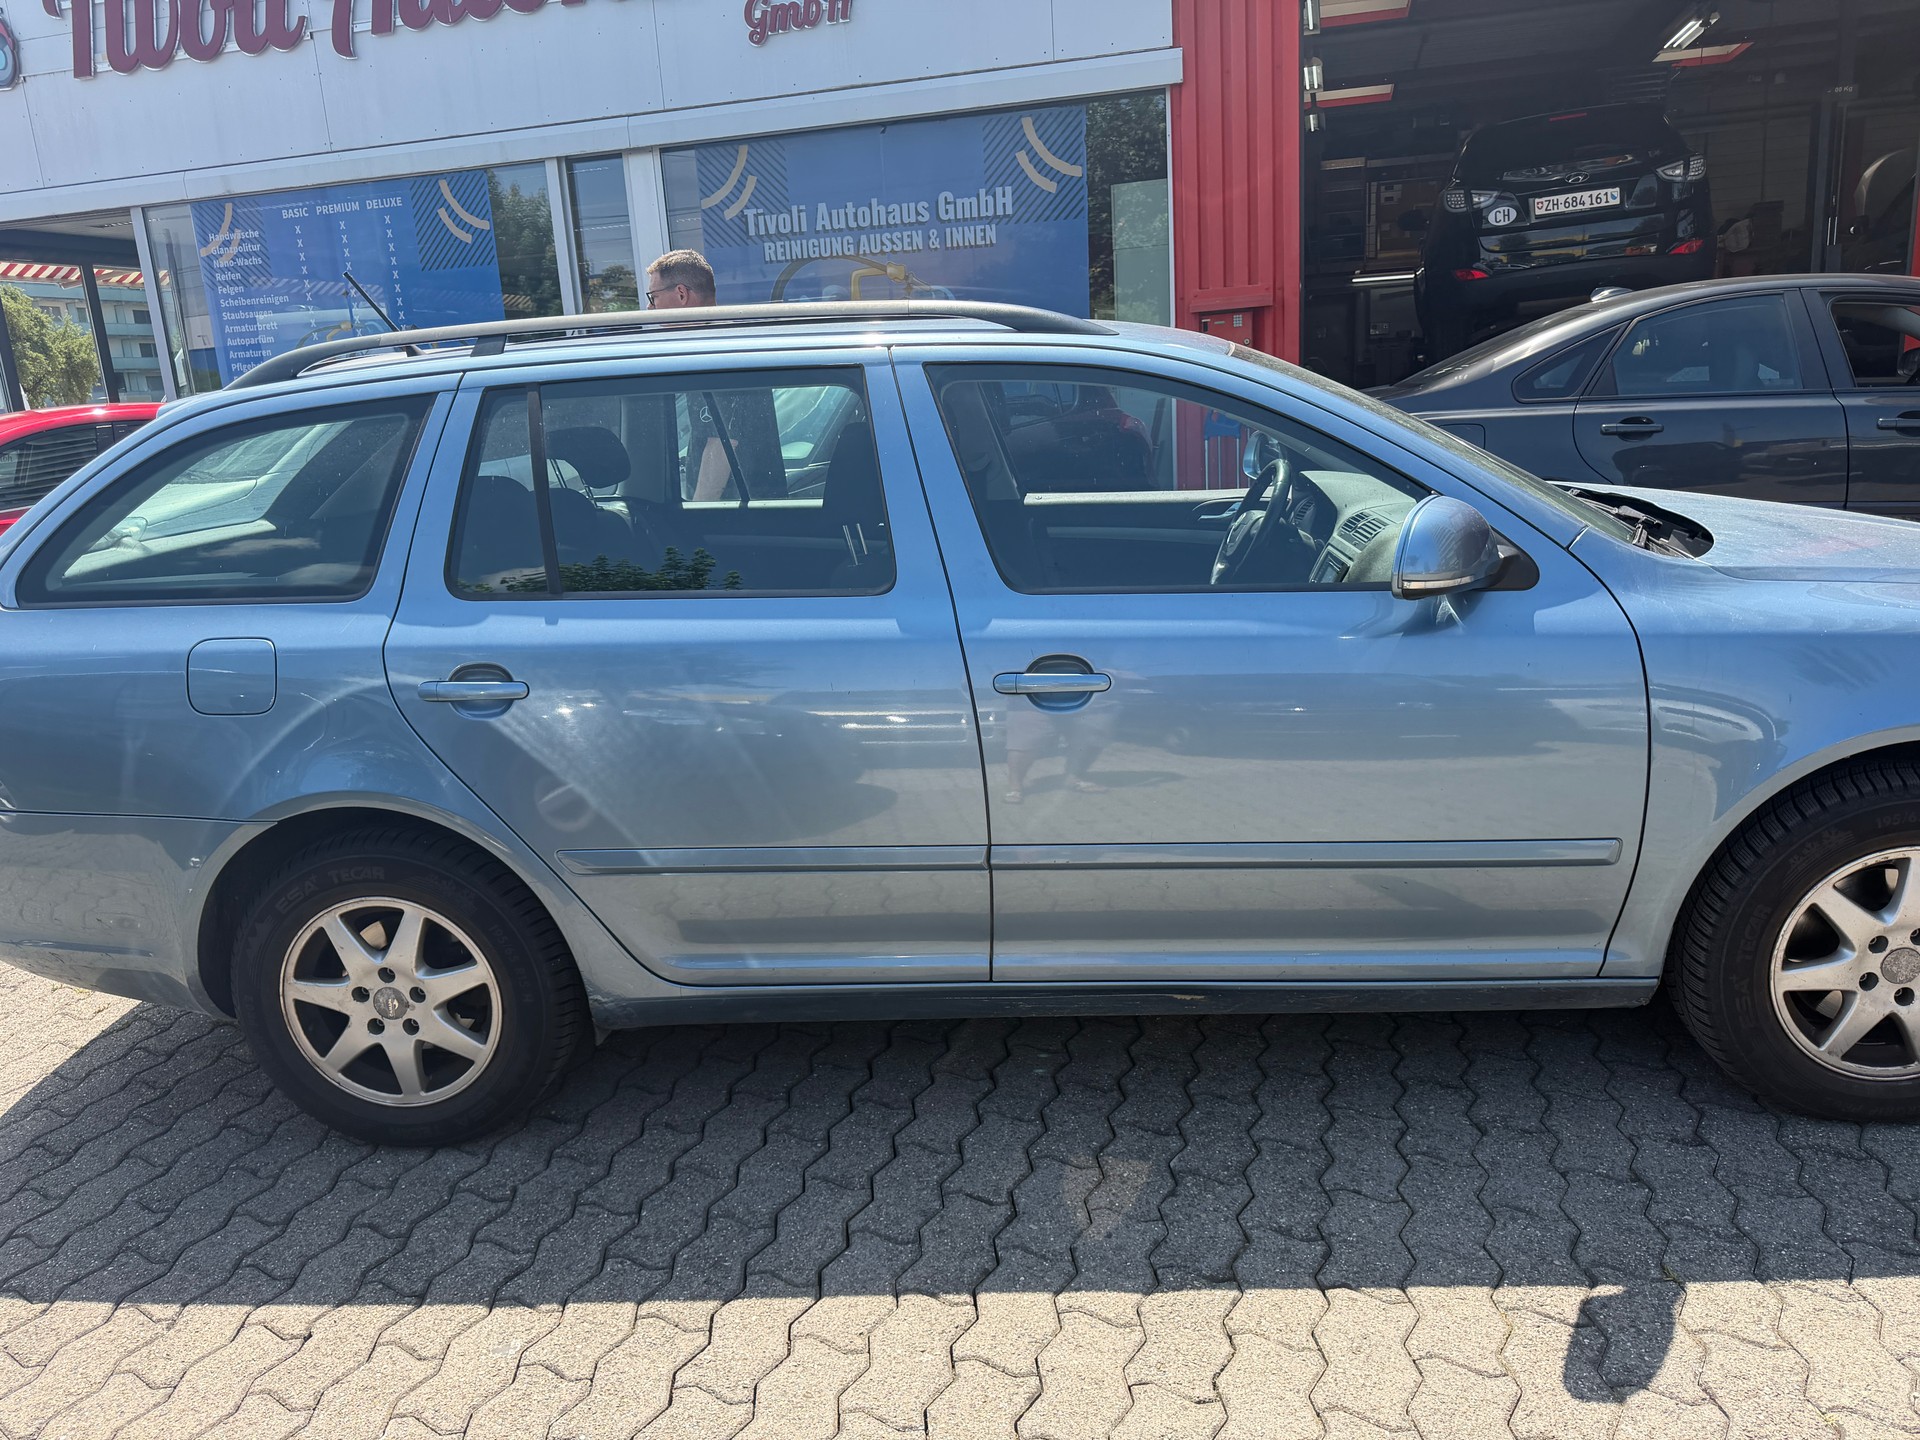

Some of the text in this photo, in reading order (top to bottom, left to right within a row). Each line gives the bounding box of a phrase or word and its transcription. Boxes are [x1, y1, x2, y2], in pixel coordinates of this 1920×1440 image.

[1589, 191, 1610, 206] 161
[282, 197, 403, 219] BASIC PREMIUM DELUXE
[744, 186, 1013, 237] Tivoli Autohaus GmbH
[1494, 210, 1511, 224] CH
[208, 229, 260, 242] Handwäsche
[763, 223, 997, 262] REINIGUNG AUSSEN & INNEN
[211, 243, 261, 256] Glanzpolitur
[213, 256, 262, 269] Nano-Wachs
[215, 272, 242, 282] Reifen
[218, 285, 245, 296] Felgen
[220, 294, 290, 308] Scheibenreinigen
[222, 309, 274, 321] Staubsaugen
[225, 322, 278, 334] Armaturbrett
[227, 335, 275, 348] Autoparfüm
[229, 349, 272, 360] Armaturen
